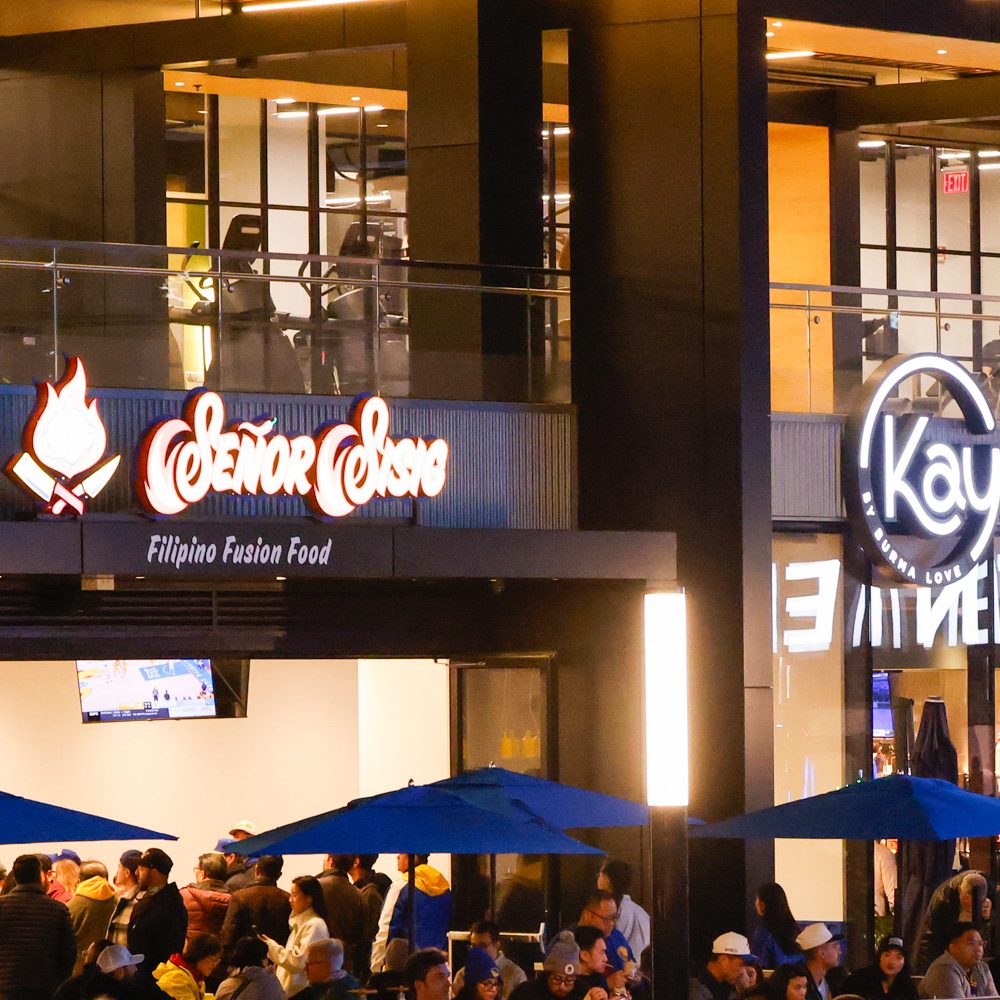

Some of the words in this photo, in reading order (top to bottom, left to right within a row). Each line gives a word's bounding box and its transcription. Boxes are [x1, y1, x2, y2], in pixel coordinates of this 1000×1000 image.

[947, 172, 967, 193] EXIT
[146, 535, 217, 569] Filipino
[222, 535, 282, 565] Fusion
[286, 536, 332, 566] Food
[862, 491, 876, 517] BY
[873, 527, 917, 580] BURMA
[925, 565, 963, 585] LOVE
